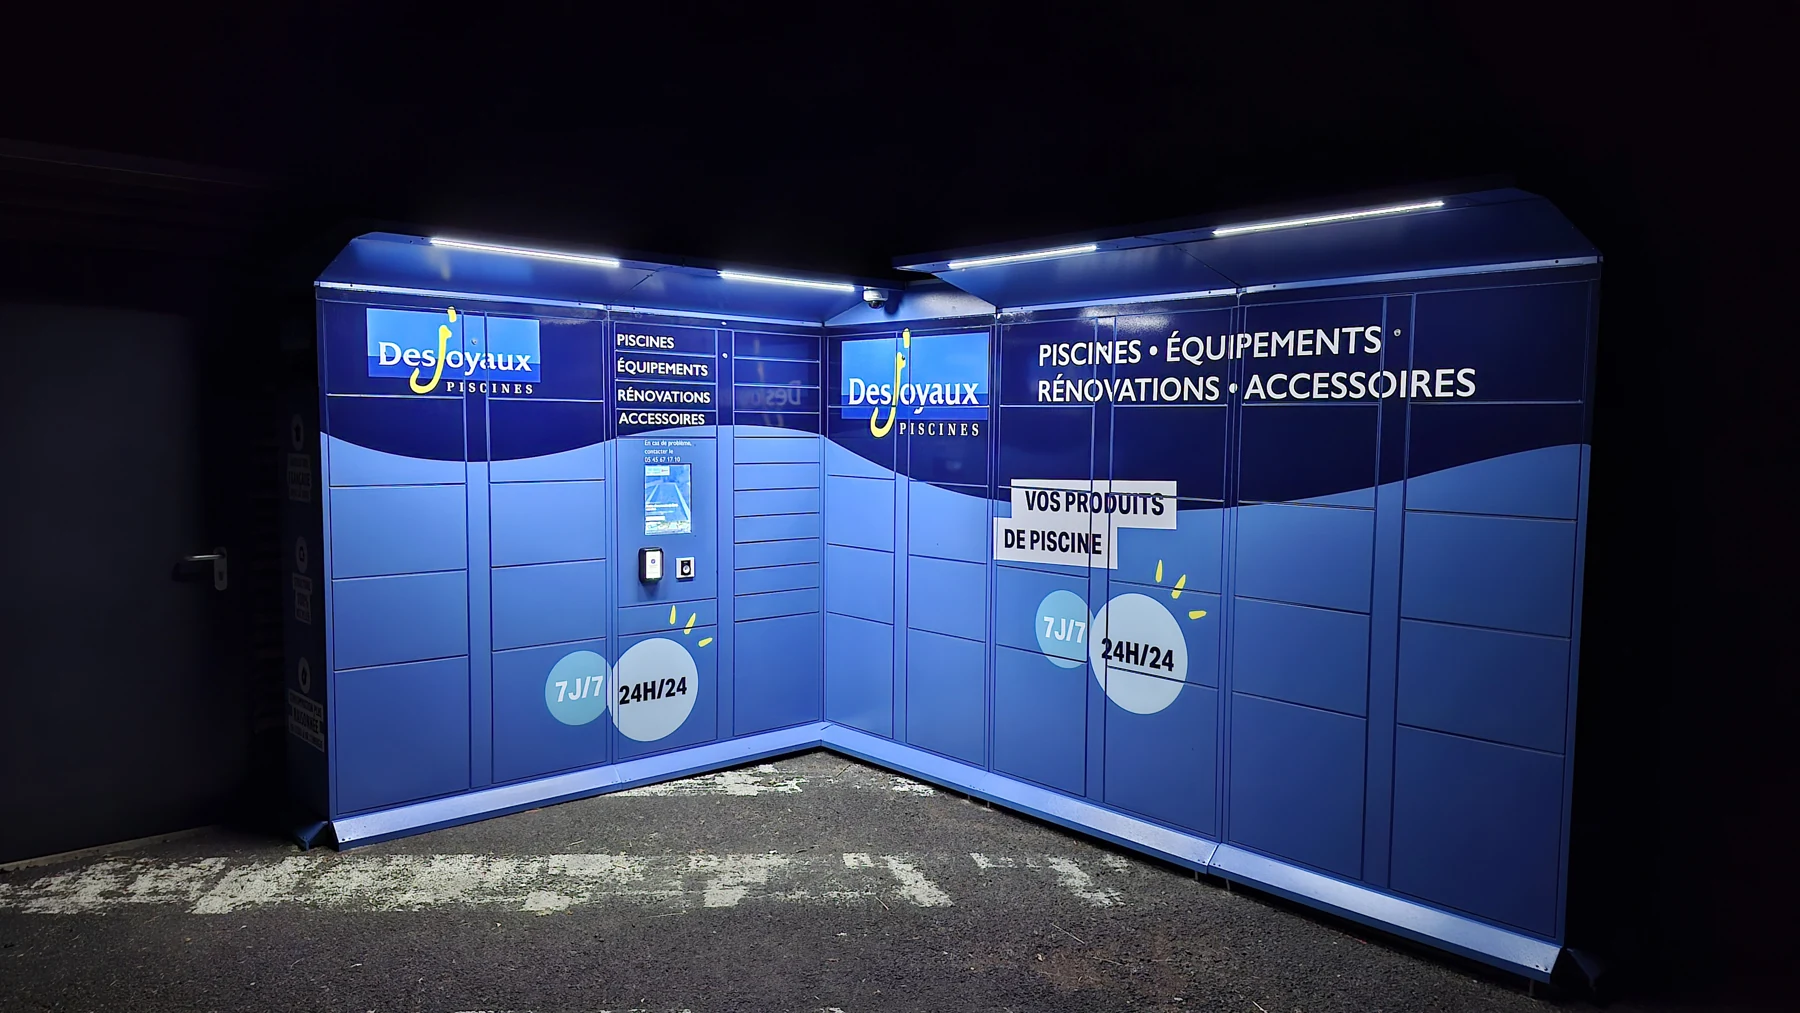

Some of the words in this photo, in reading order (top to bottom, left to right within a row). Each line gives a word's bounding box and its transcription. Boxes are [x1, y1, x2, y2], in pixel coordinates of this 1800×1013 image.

[616, 333, 675, 349] PISCINES
[1038, 339, 1142, 367] PISCINES
[1165, 325, 1381, 366] ÉQUIPEMENTS
[617, 357, 709, 377] ÉQUIPEMENTS
[446, 381, 533, 394] PISCINES
[617, 386, 711, 404] RÉNOVATIONS
[1037, 373, 1220, 402] RÉNOVATIONS
[1243, 367, 1476, 399] ACCESSOIRES
[618, 412, 705, 425] ACCESSOIRES
[899, 422, 979, 436] PISCINES
[1025, 490, 1061, 512] VOS
[1065, 491, 1165, 516] PRODUITS
[1004, 528, 1026, 549] DE
[1030, 530, 1102, 555] PISCINE
[1043, 616, 1086, 644] 7J/7
[1101, 637, 1175, 672] 24H/24
[555, 675, 604, 702] 7J/7
[618, 676, 688, 705] 24H/24
